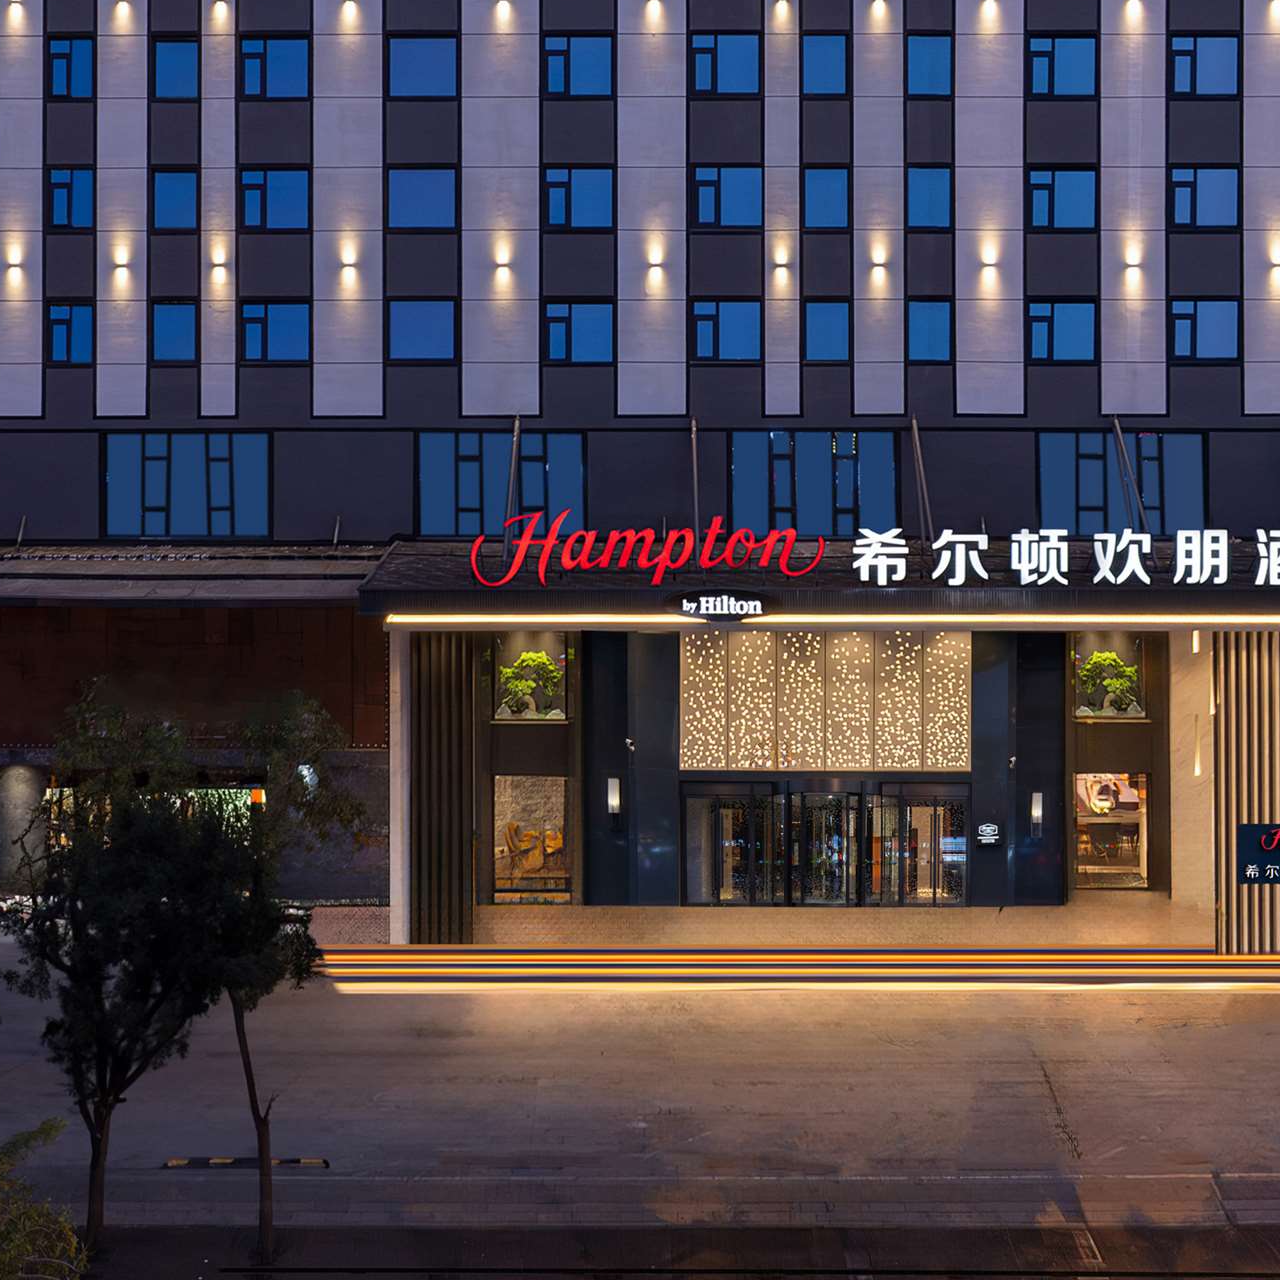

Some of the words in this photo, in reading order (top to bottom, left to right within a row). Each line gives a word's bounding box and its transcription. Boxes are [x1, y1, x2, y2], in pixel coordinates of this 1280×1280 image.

[470, 508, 825, 588] Hampton
[682, 598, 697, 614] by
[699, 595, 763, 614] Hilton
